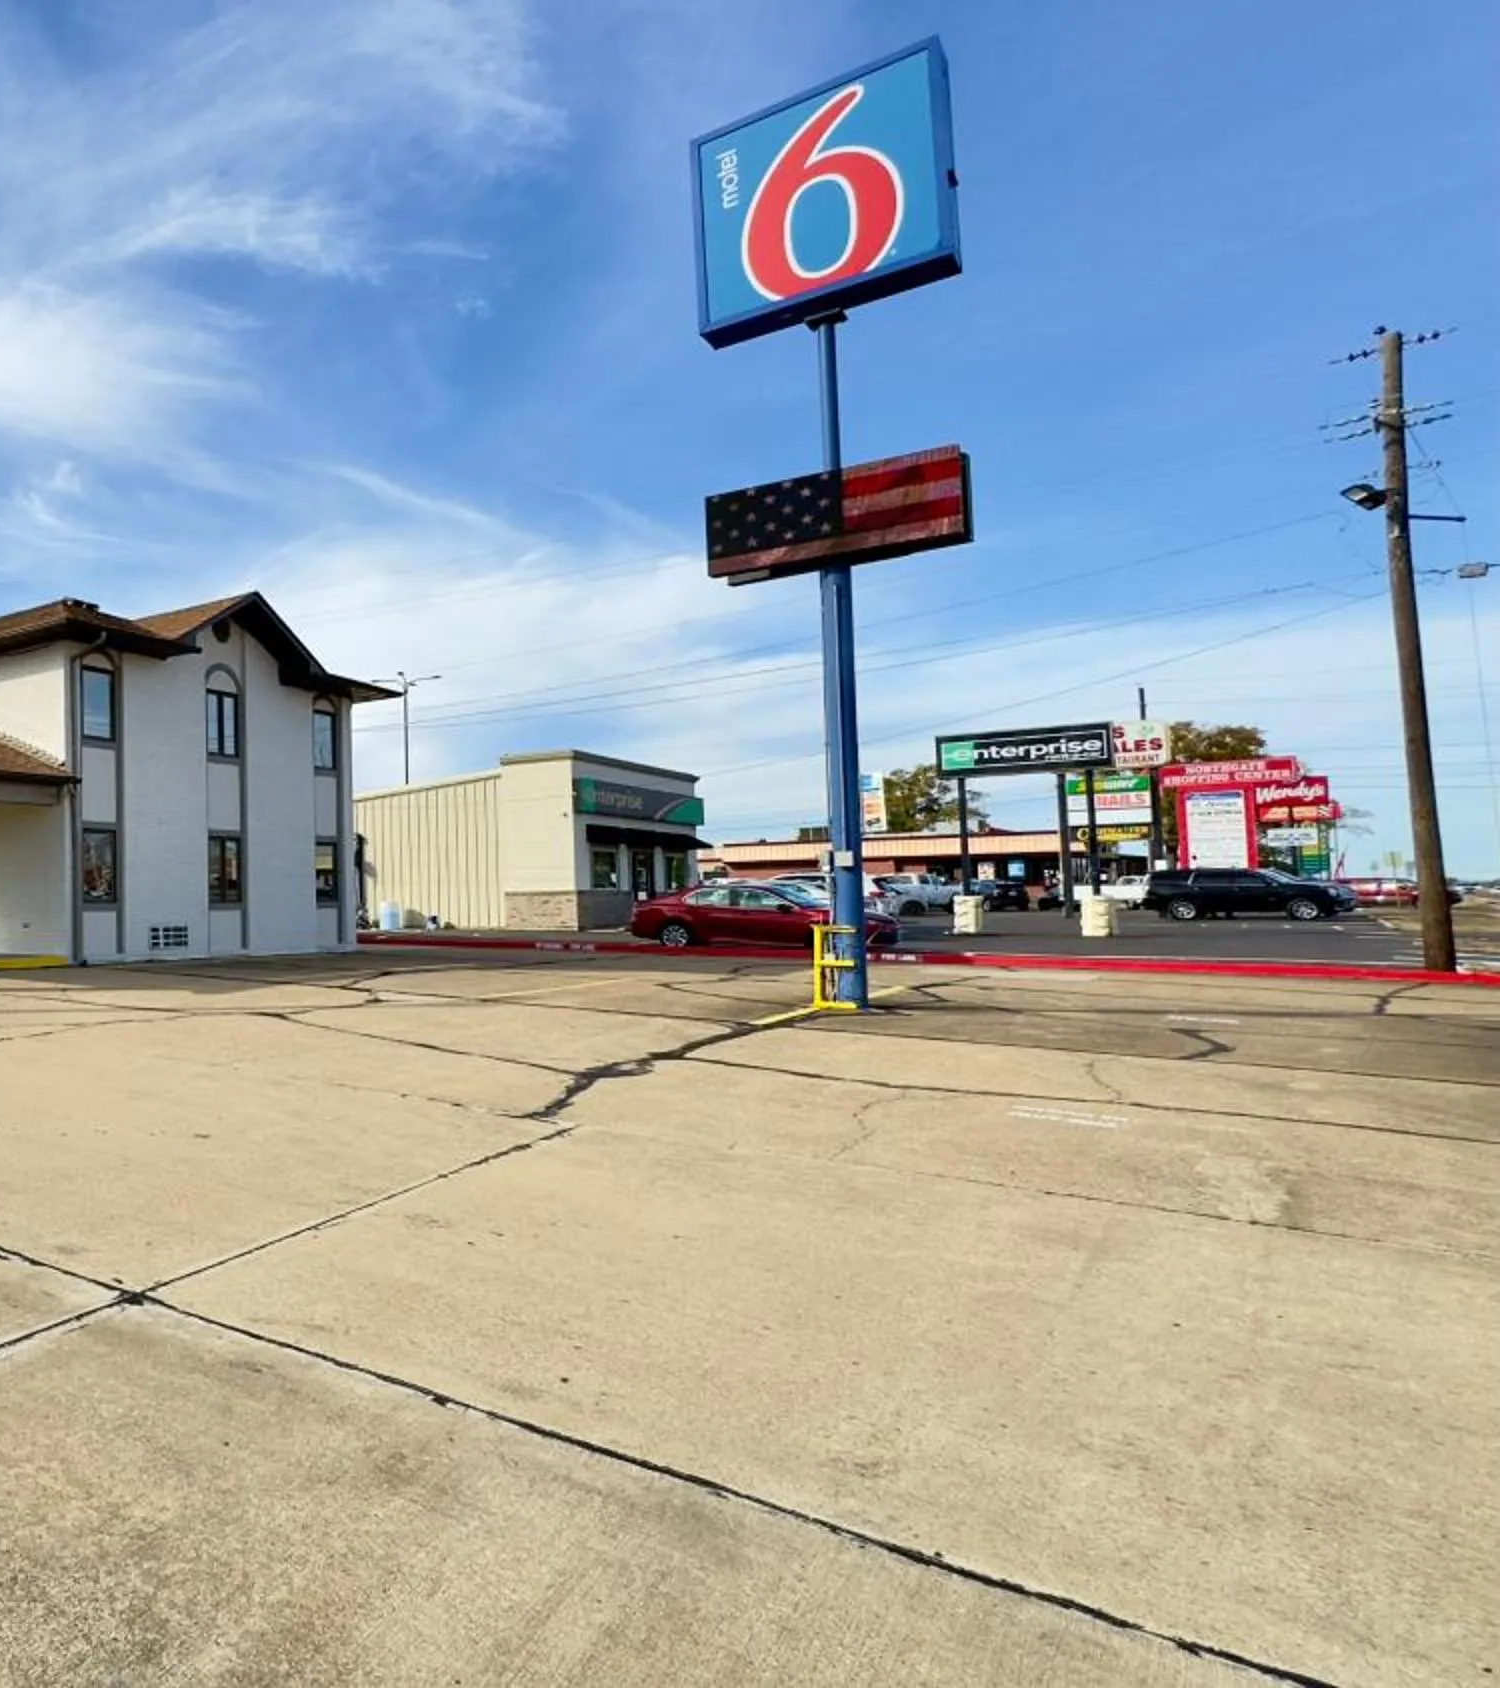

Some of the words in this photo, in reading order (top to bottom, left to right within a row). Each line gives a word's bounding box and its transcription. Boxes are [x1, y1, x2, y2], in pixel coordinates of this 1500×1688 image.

[716, 147, 739, 209] motel
[742, 83, 904, 301] 6
[951, 738, 1102, 762] enterprise
[1164, 773, 1230, 785] SHOPPING
[1235, 769, 1291, 781] CENTER
[1185, 761, 1265, 776] NORTHGATE
[1075, 778, 1141, 793] SBWAY
[1256, 781, 1325, 804] Wendy's
